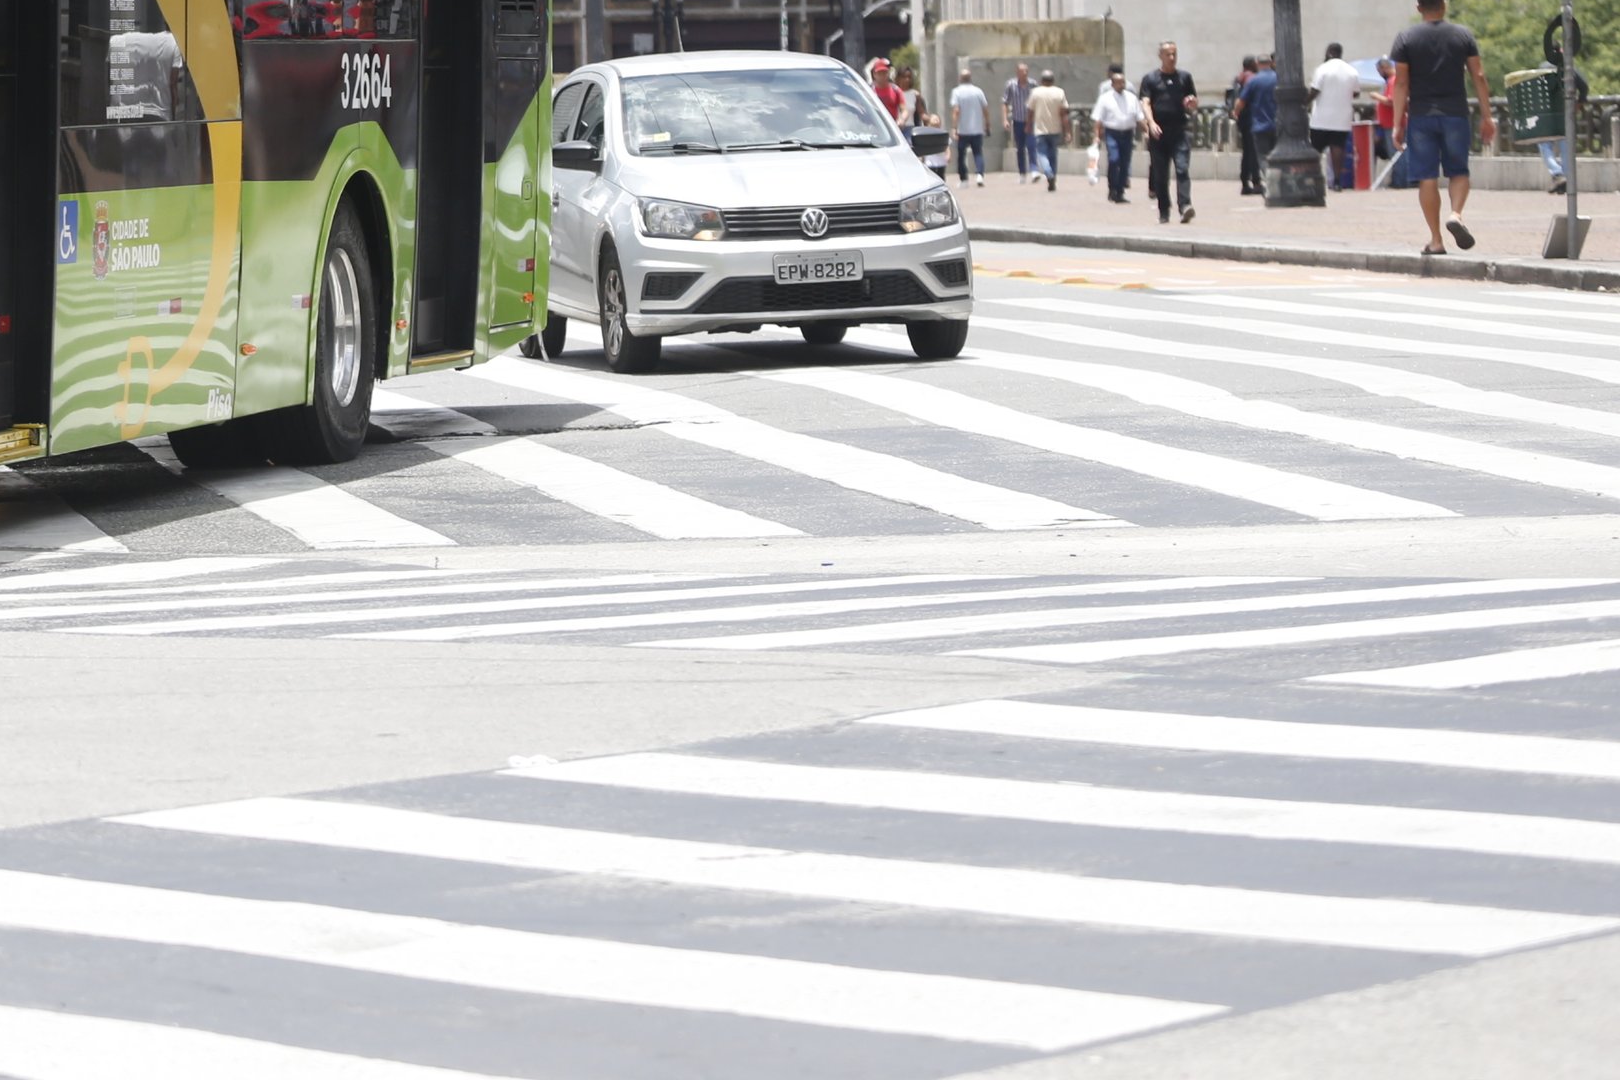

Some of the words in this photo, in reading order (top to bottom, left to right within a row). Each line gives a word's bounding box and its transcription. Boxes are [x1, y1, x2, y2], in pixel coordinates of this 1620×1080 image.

[112, 220, 138, 240] CIDADE
[139, 219, 149, 237] DE
[111, 242, 130, 272] SÃO
[131, 243, 160, 269] PAULO
[778, 261, 857, 280] EPW-8282
